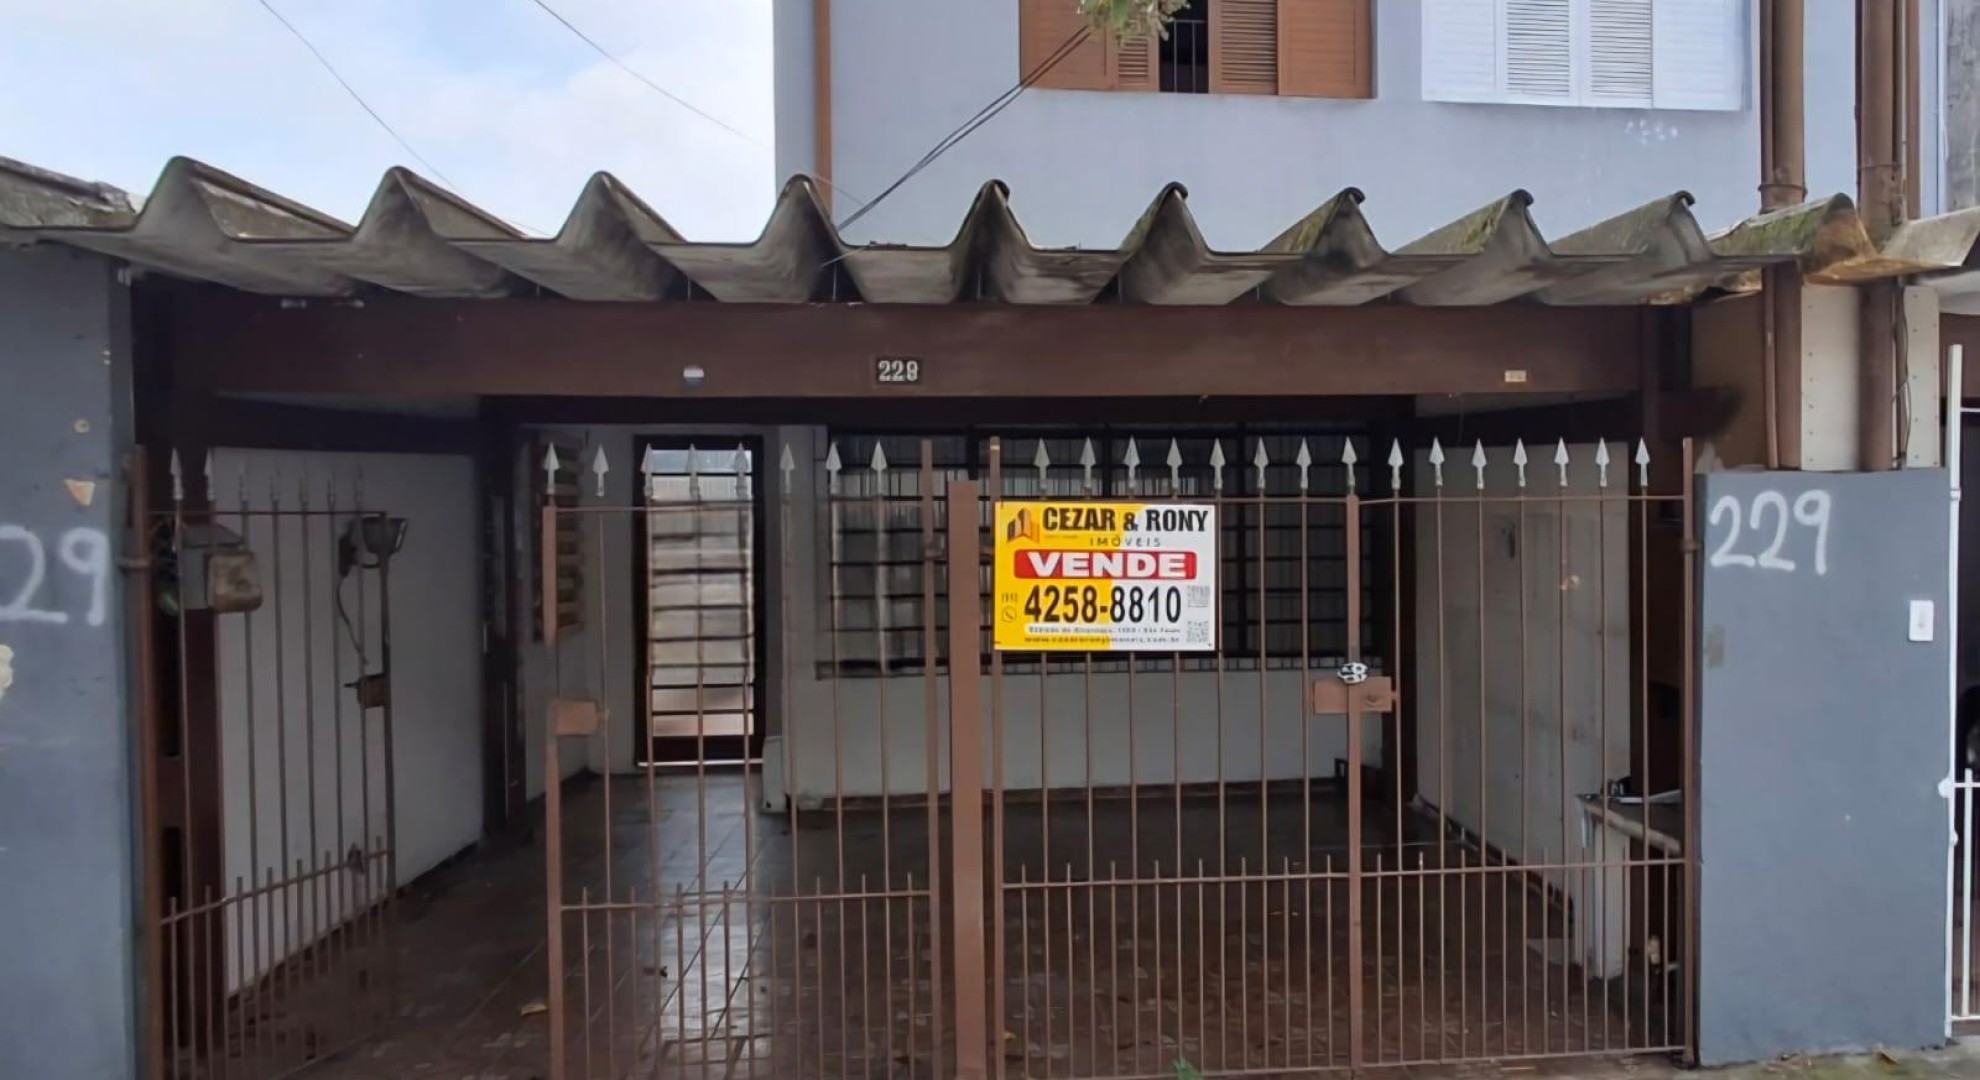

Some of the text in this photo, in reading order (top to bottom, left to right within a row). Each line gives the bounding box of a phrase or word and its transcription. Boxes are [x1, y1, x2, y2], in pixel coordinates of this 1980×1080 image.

[1043, 507, 1209, 532] CEZAR & RONY
[1090, 534, 1162, 547] IMÓVEIS
[1710, 490, 1831, 575] 229
[1027, 552, 1186, 577] VENDE
[1024, 585, 1181, 623] 4258-8810
